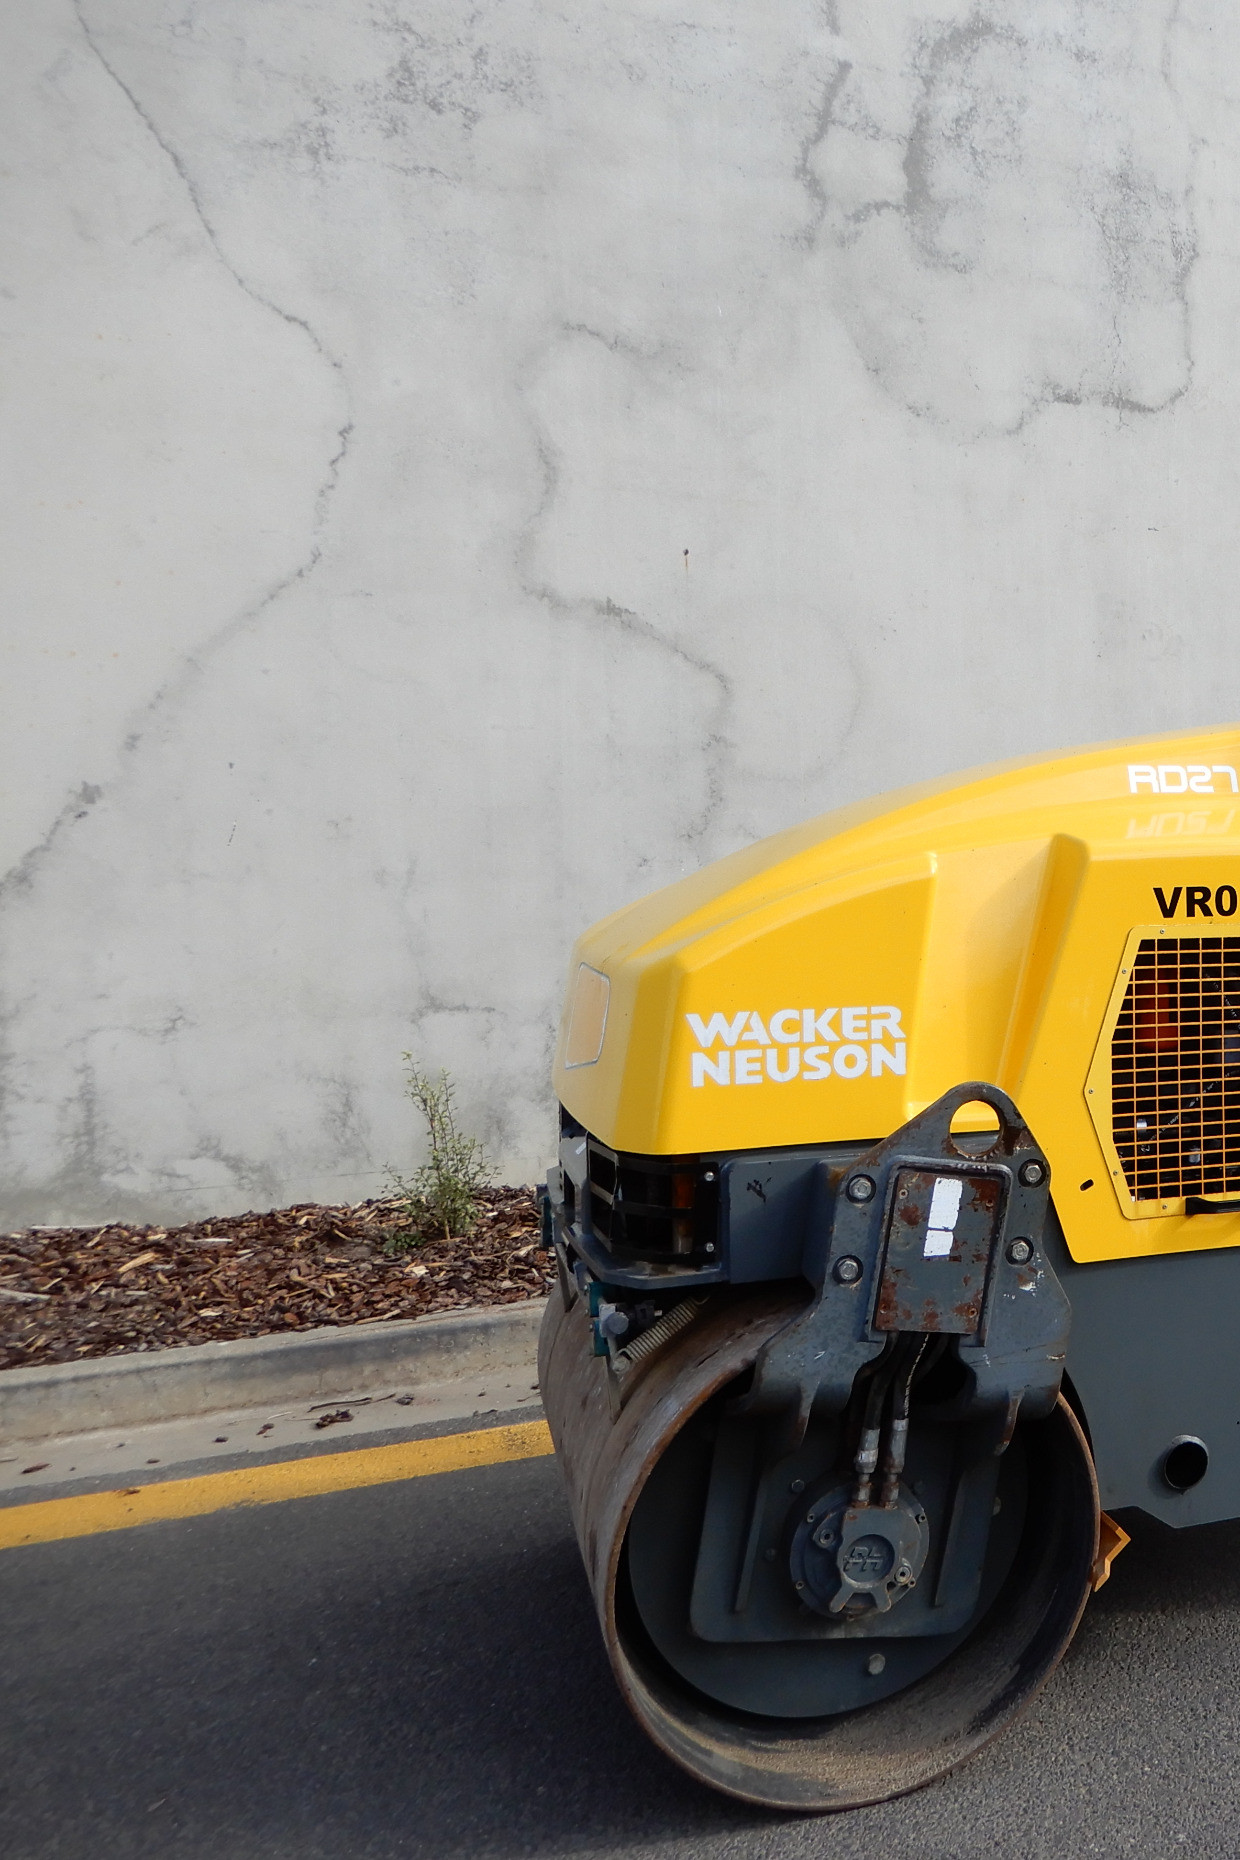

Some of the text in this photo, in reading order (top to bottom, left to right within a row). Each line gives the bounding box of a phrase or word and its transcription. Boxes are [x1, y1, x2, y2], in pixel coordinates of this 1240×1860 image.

[1127, 764, 1239, 794] RD27
[685, 1005, 907, 1048] WACKER
[691, 1042, 907, 1087] NEUSON
